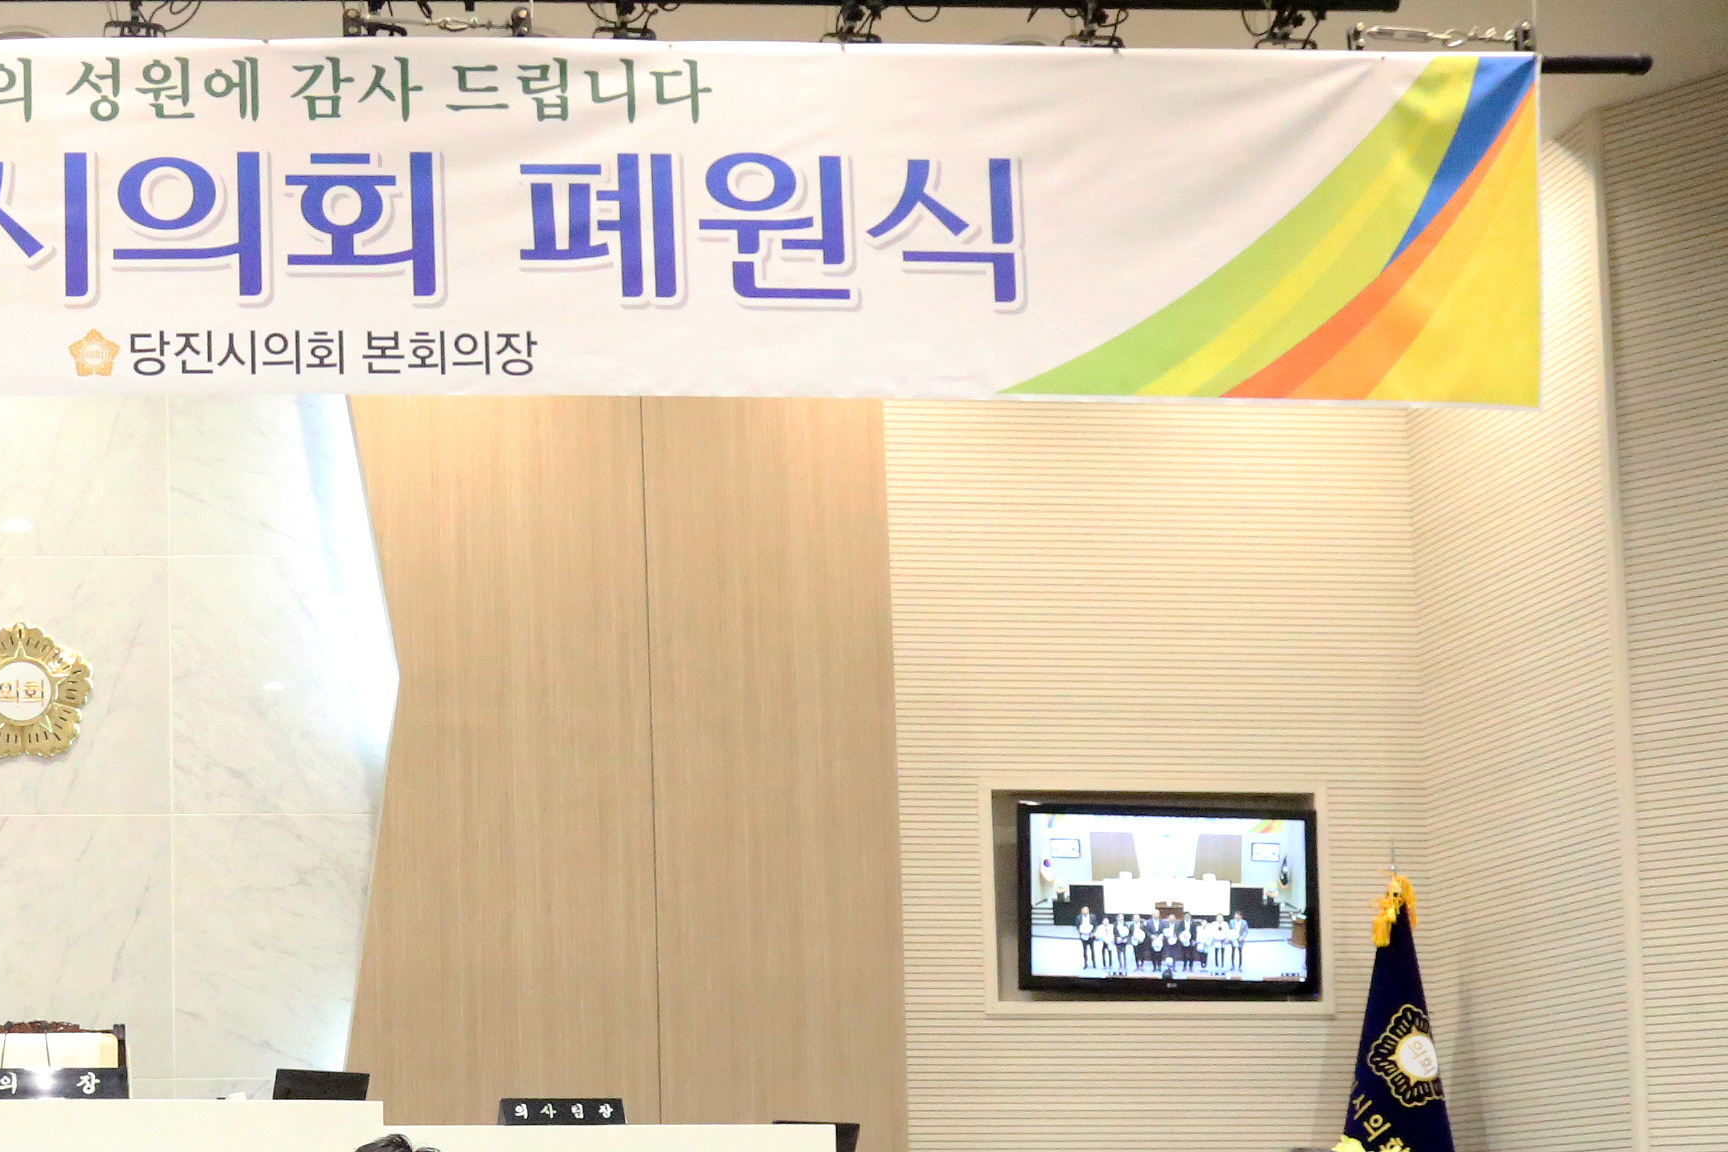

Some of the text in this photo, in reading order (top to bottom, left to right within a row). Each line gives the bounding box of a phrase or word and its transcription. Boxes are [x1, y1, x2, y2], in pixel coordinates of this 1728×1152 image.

[69, 57, 259, 123] 성원에
[291, 57, 423, 123] 감사
[446, 57, 713, 124] 드립니다
[519, 151, 1017, 303] 폐원식
[129, 330, 539, 376] 당진시의회 본회의장
